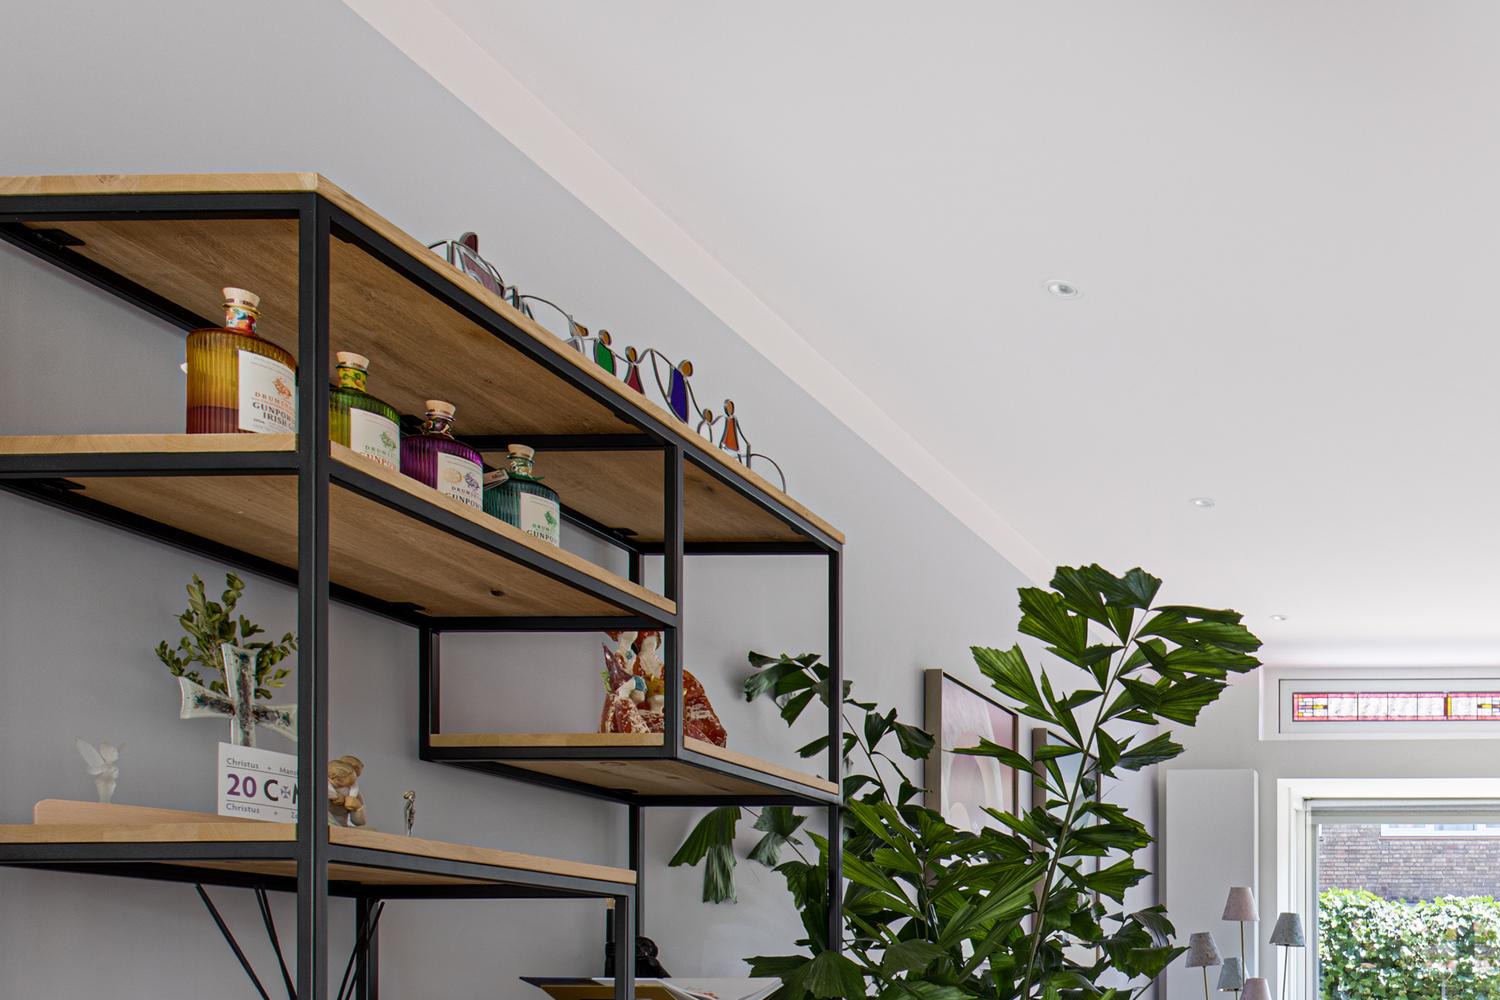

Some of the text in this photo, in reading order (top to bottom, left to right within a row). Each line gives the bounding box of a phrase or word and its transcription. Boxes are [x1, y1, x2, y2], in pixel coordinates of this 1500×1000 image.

[226, 757, 259, 769] Christus
[227, 773, 257, 798] 20
[226, 803, 260, 814] Christus
